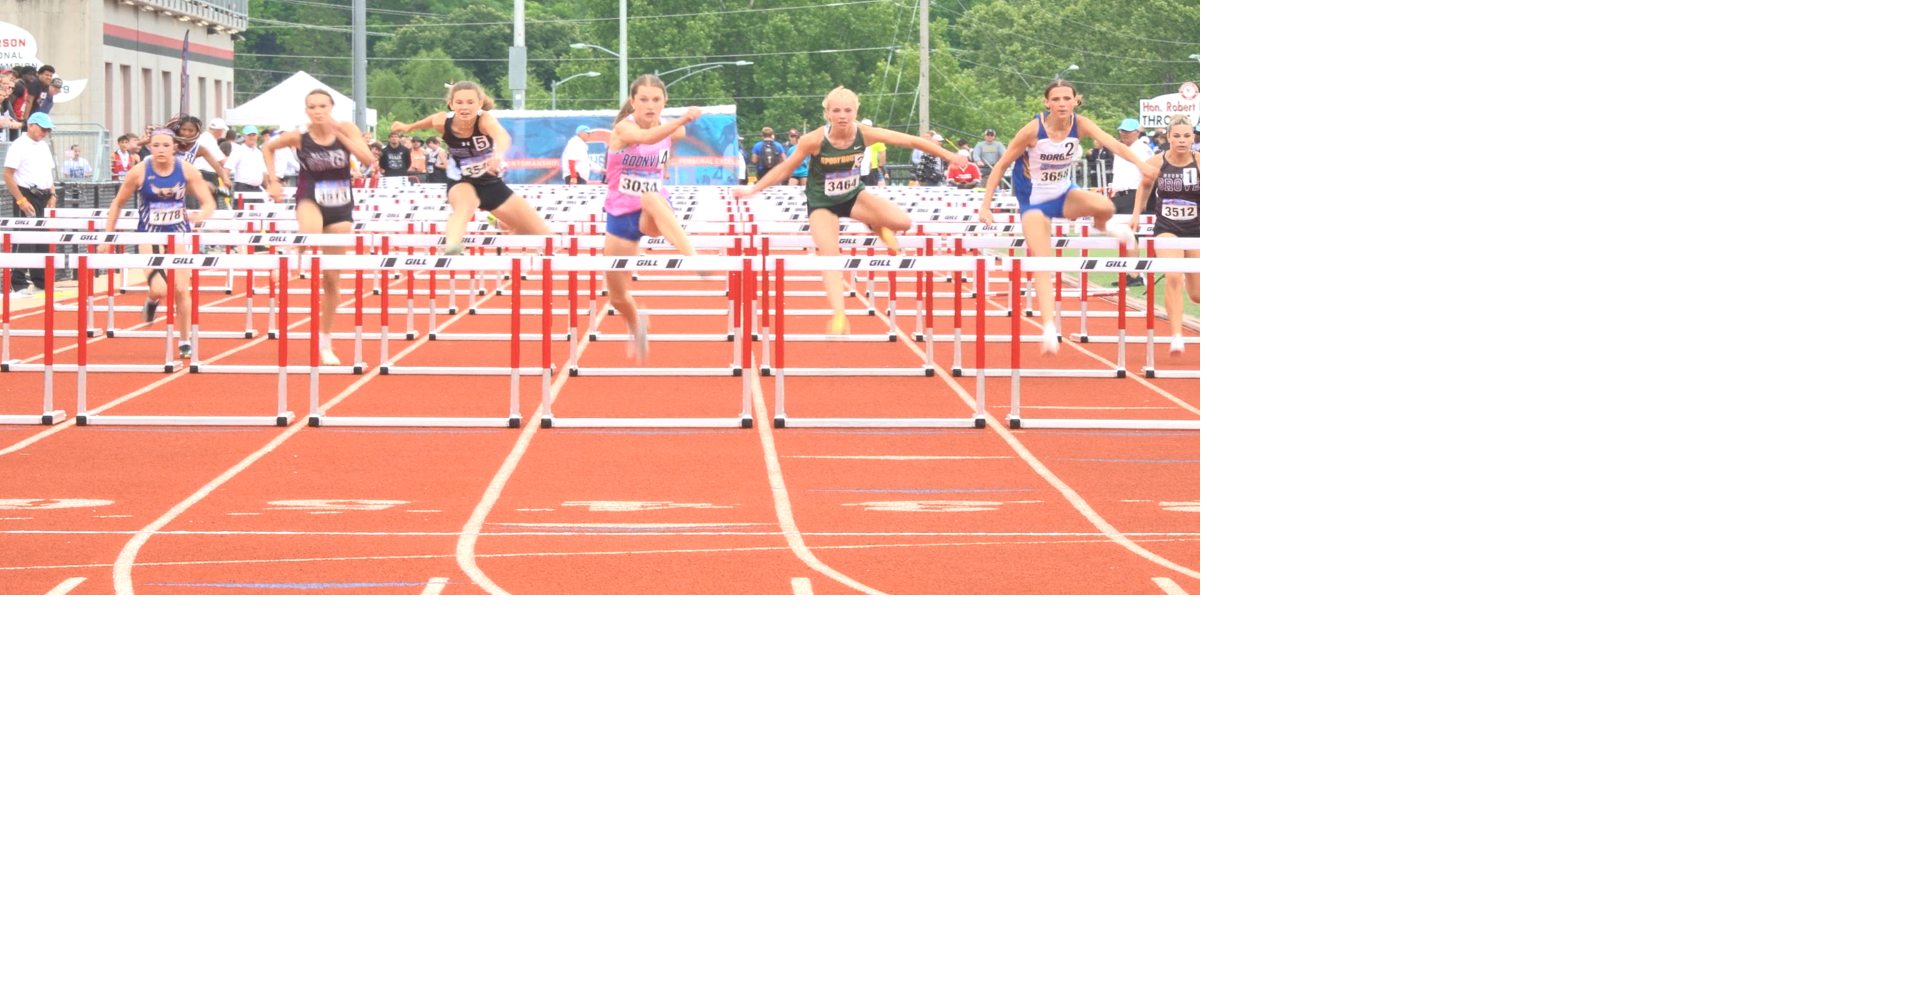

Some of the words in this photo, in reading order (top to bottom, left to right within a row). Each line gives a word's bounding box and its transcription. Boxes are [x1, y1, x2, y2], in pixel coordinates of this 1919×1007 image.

[1142, 102, 1162, 112] Hon.
[1166, 100, 1196, 112] Robert
[475, 136, 487, 150] 5
[1064, 142, 1074, 156] 2
[1186, 170, 1193, 184] 1
[154, 210, 180, 221] 3778
[1164, 206, 1194, 217] 3512
